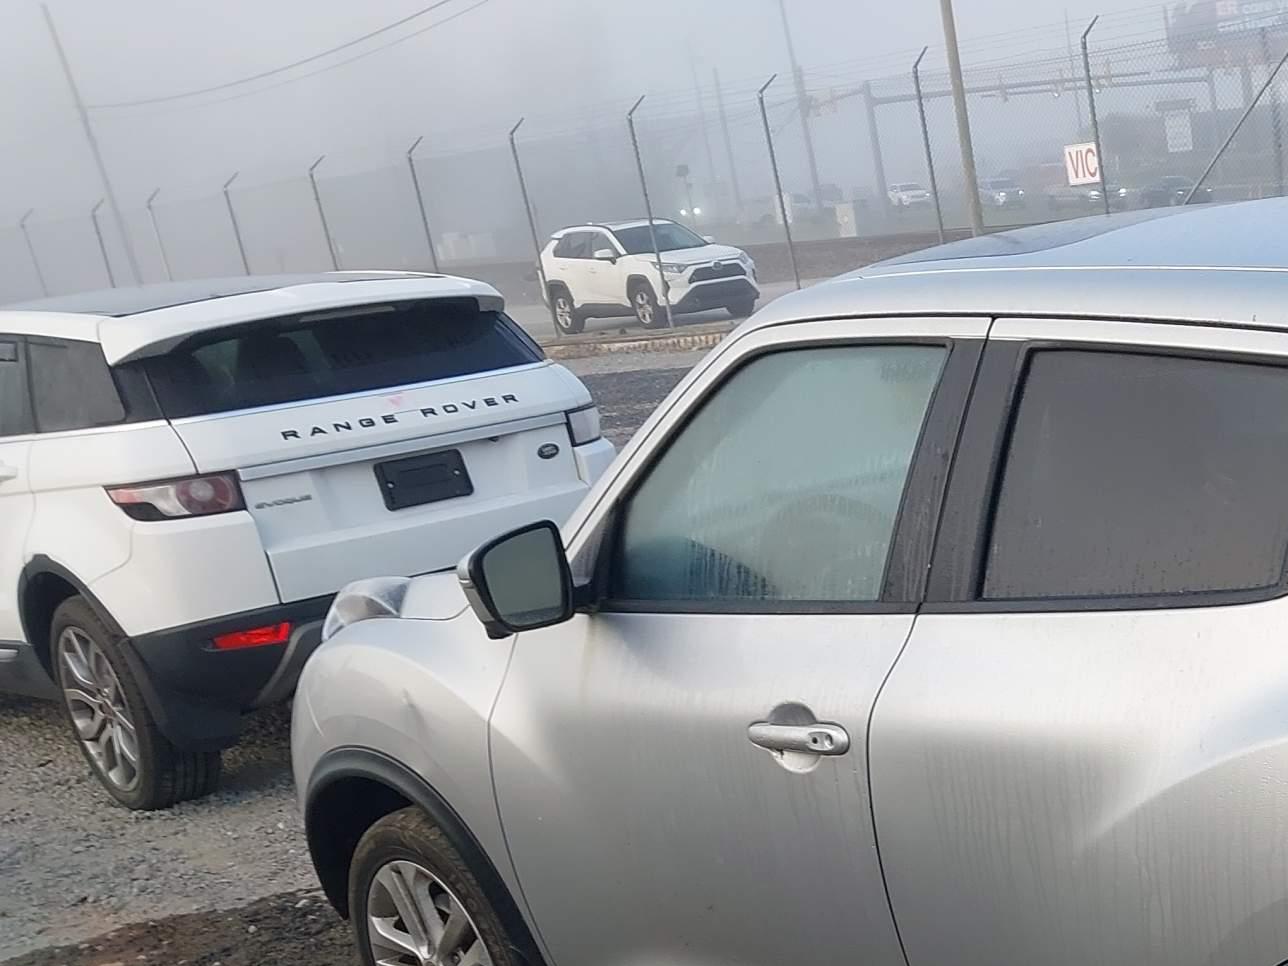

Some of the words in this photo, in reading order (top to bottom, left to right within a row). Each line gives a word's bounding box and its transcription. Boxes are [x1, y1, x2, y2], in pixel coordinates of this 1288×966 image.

[1068, 148, 1098, 179] VIC
[280, 413, 399, 441] RANGE
[420, 394, 519, 417] ROVER
